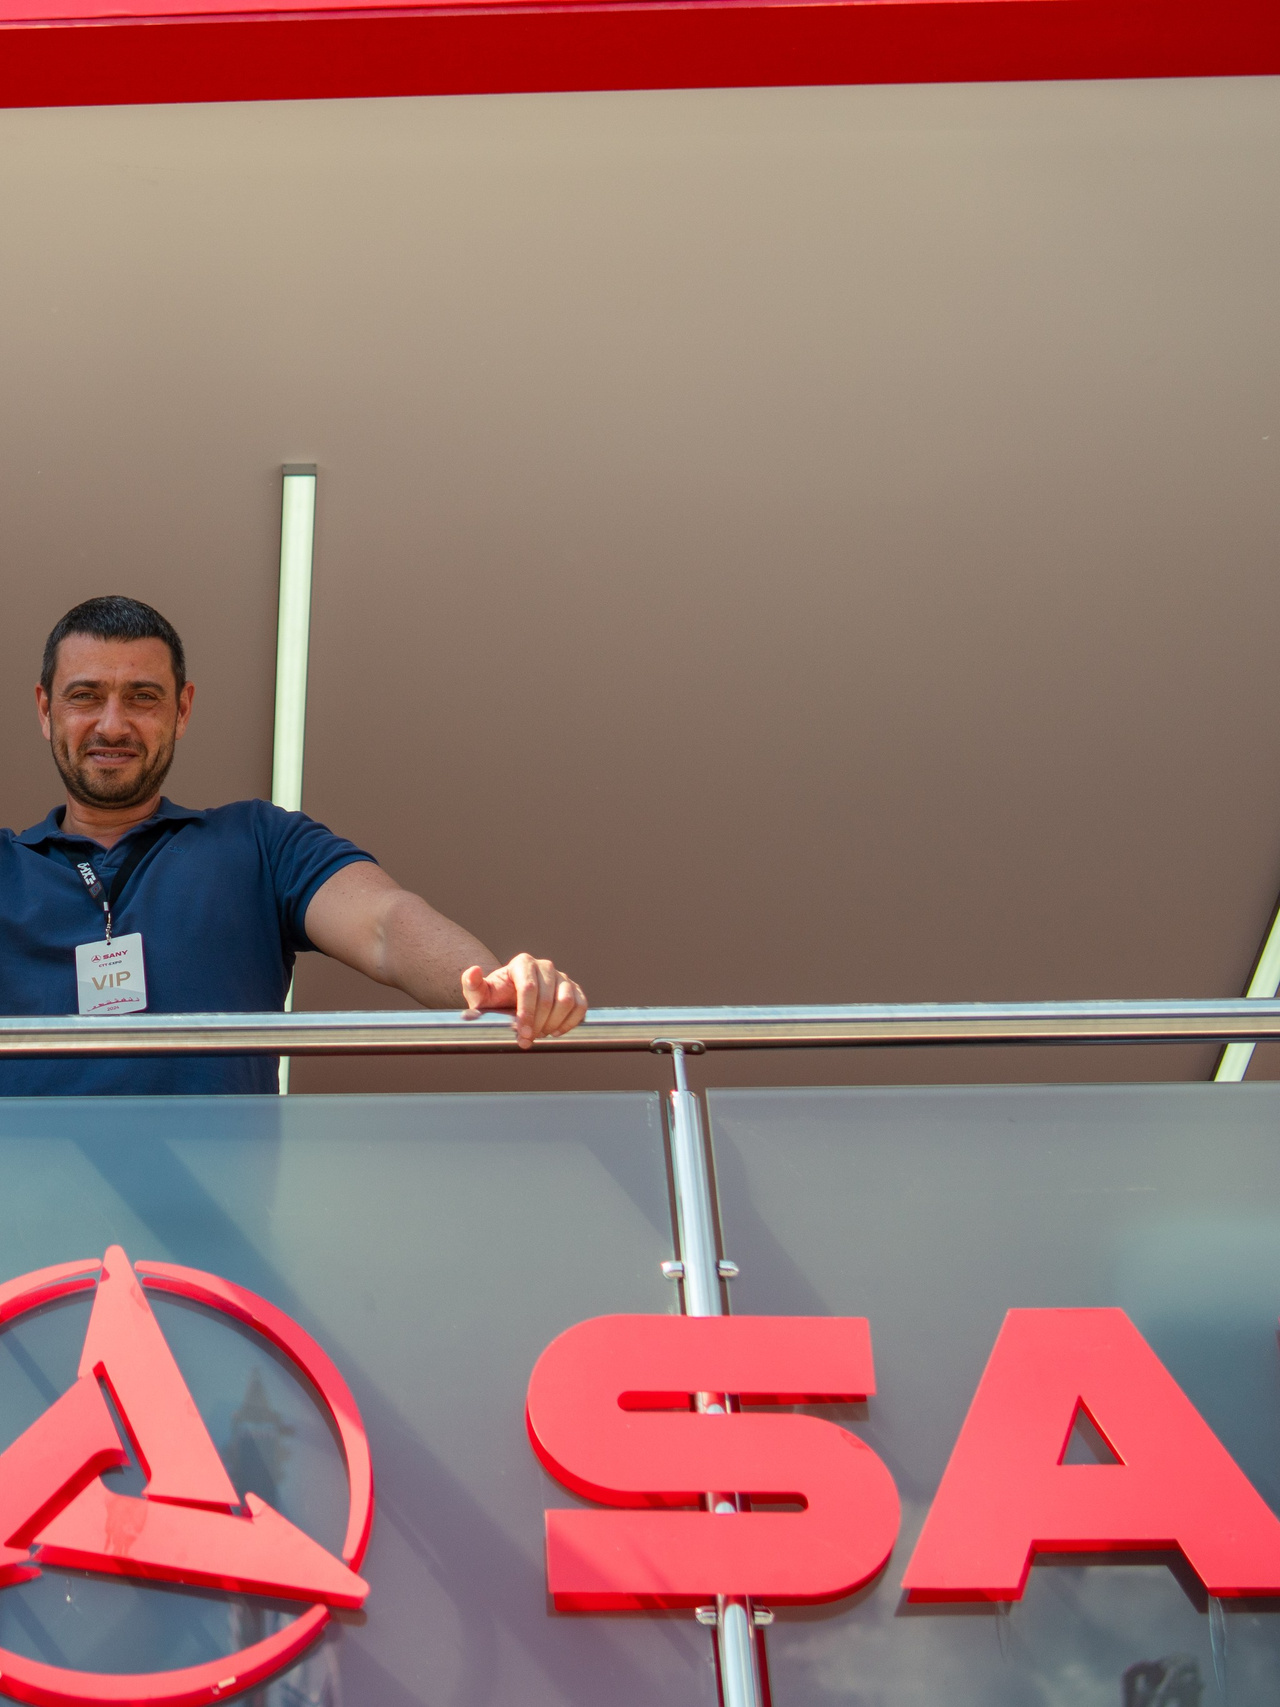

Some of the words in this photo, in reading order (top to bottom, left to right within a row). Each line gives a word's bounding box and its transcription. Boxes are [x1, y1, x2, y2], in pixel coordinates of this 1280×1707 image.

[102, 950, 128, 960] SANY
[91, 970, 131, 991] VIP
[526, 1308, 1280, 1611] SA
